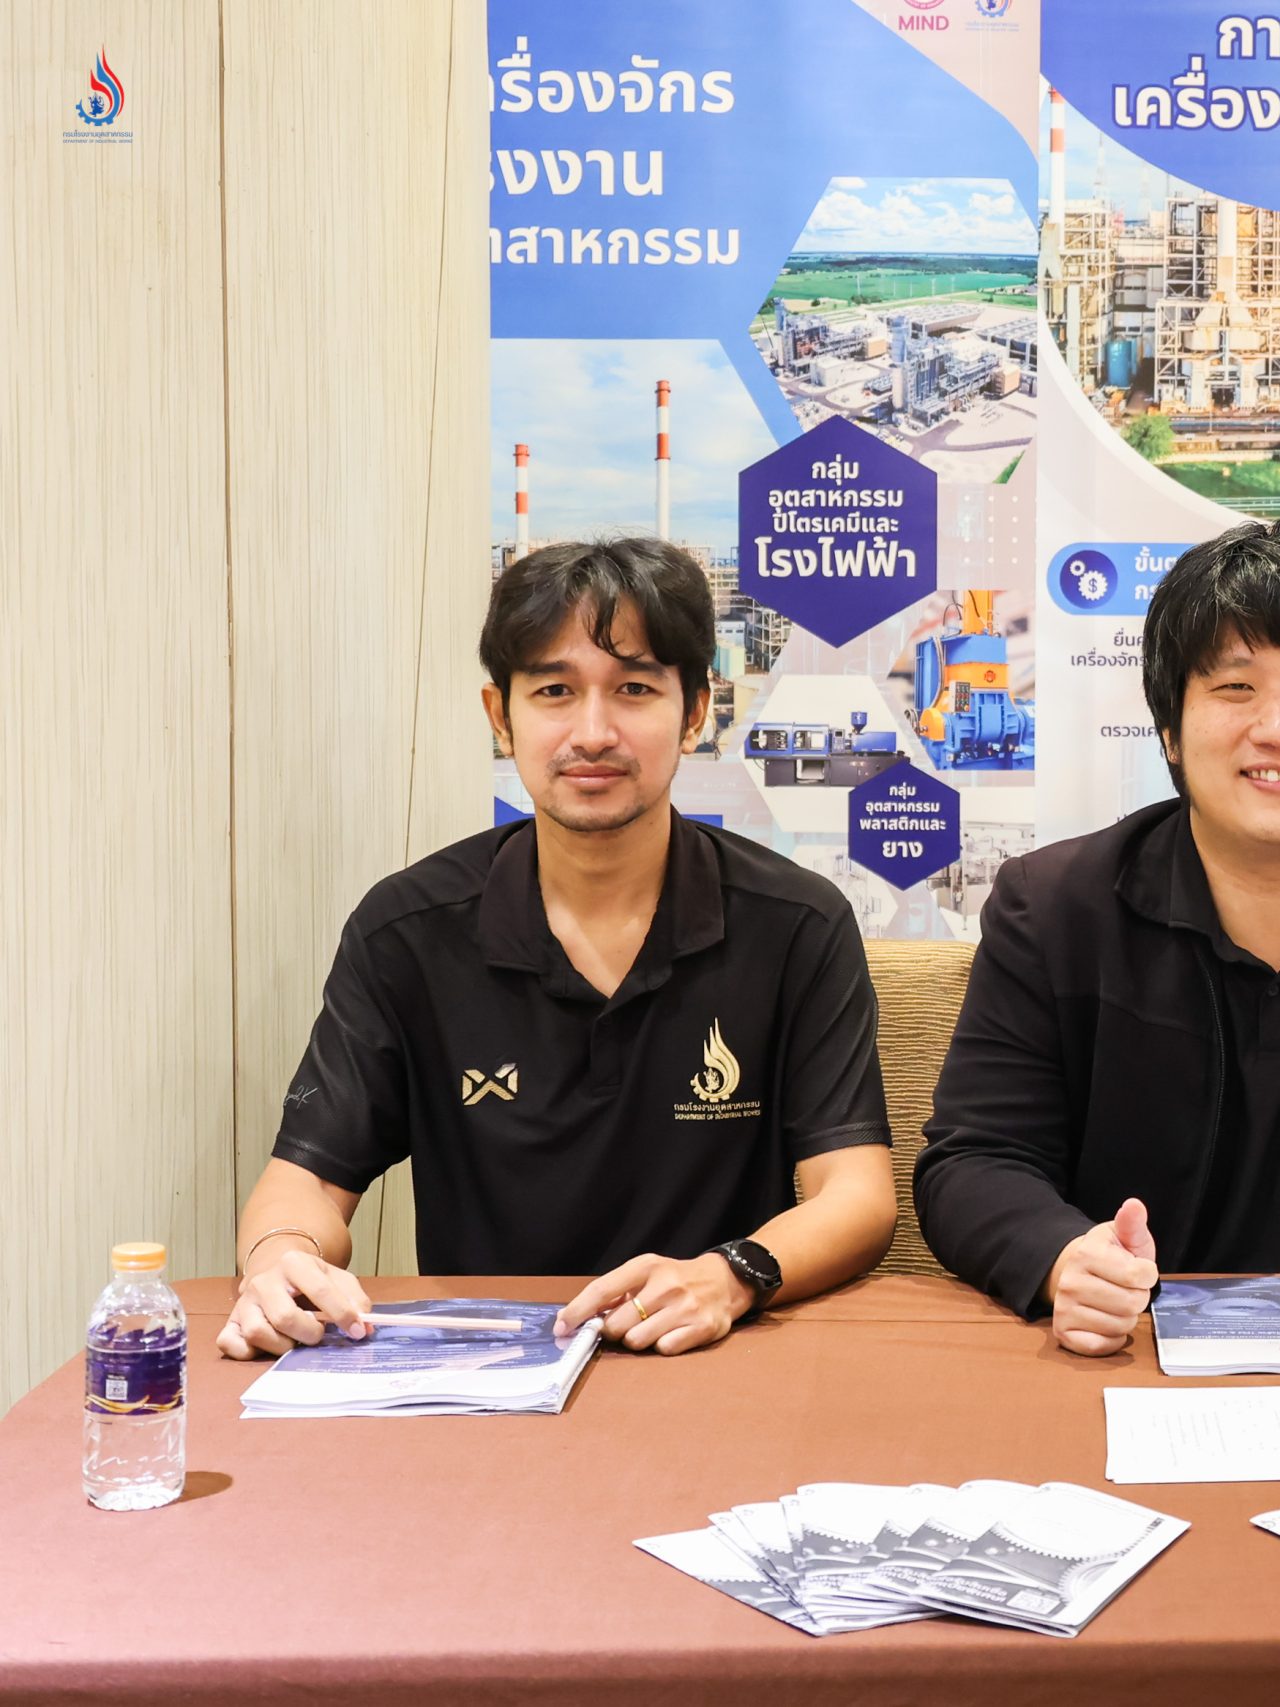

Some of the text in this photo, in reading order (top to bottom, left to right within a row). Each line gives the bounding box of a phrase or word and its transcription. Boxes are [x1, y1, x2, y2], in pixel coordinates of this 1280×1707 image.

[898, 15, 949, 31] MIND
[811, 454, 859, 486] กลุ่ม
[768, 489, 904, 515] อุตสาหกรรม
[754, 536, 916, 578] โรงไฟฟ้า
[889, 782, 916, 800] กลุ่ม
[865, 801, 940, 814] อุตสาหกรรม
[859, 816, 947, 832] พลาสติกและ
[882, 840, 923, 858] ยาง
